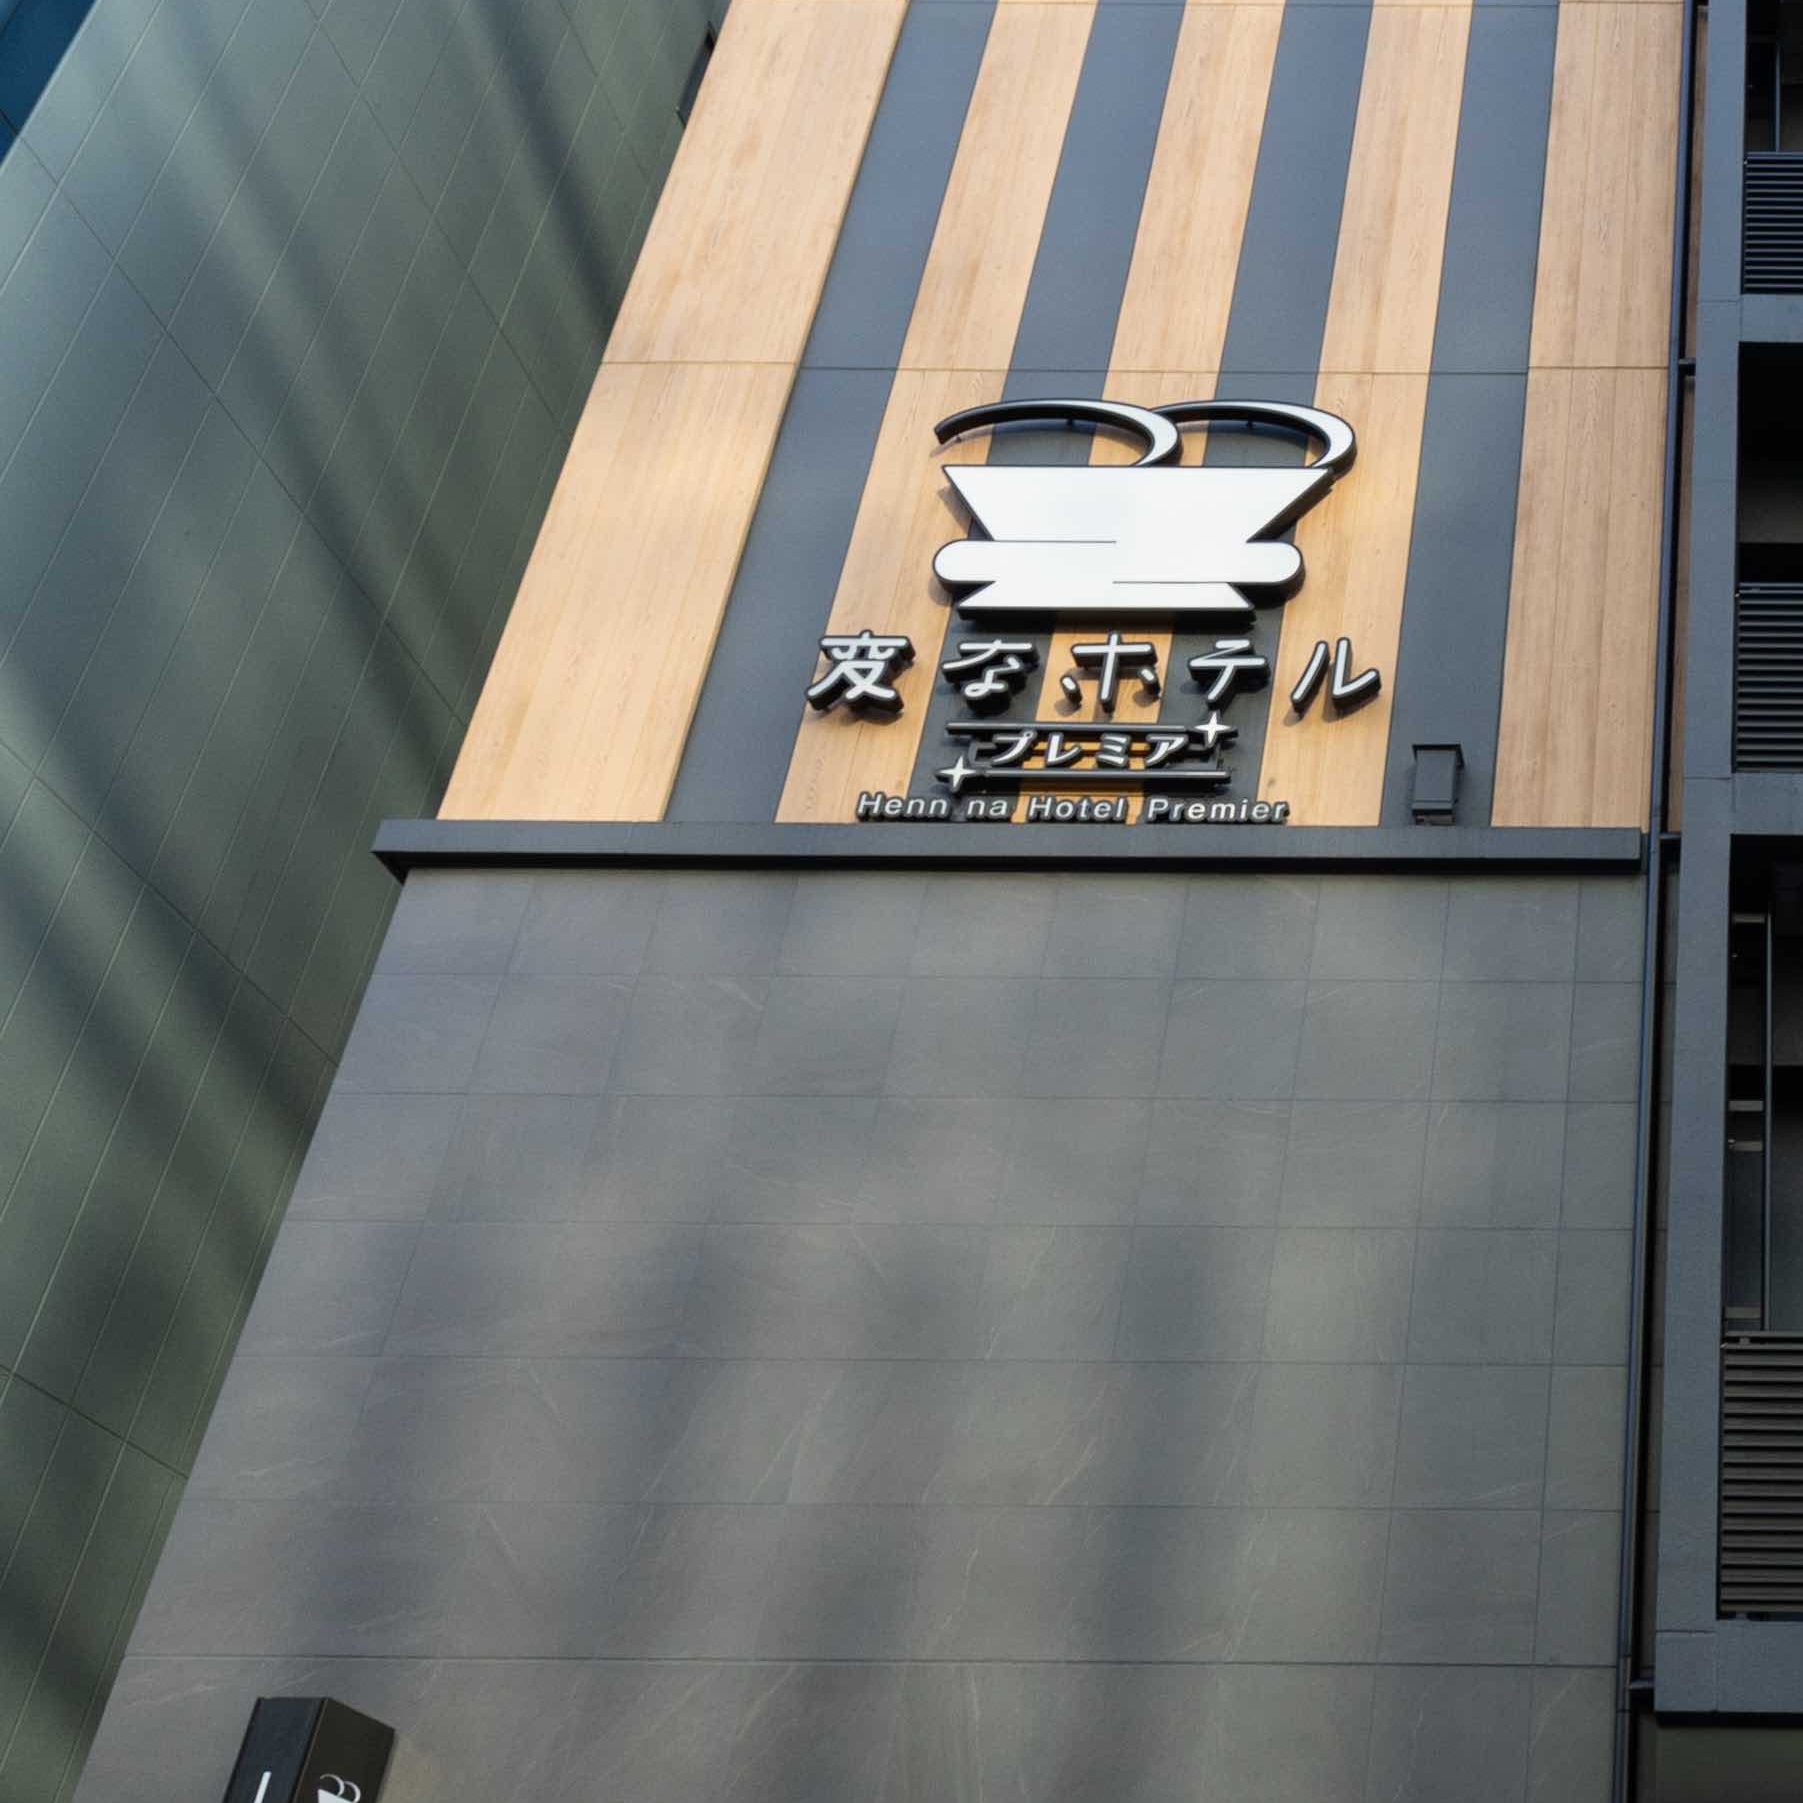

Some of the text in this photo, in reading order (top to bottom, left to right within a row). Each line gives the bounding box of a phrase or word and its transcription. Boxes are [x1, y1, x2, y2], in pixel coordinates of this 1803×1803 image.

[805, 630, 1382, 714] 変なホテル
[988, 730, 1190, 767] プレミア
[857, 791, 1291, 826] Henn na Hotel Premier
